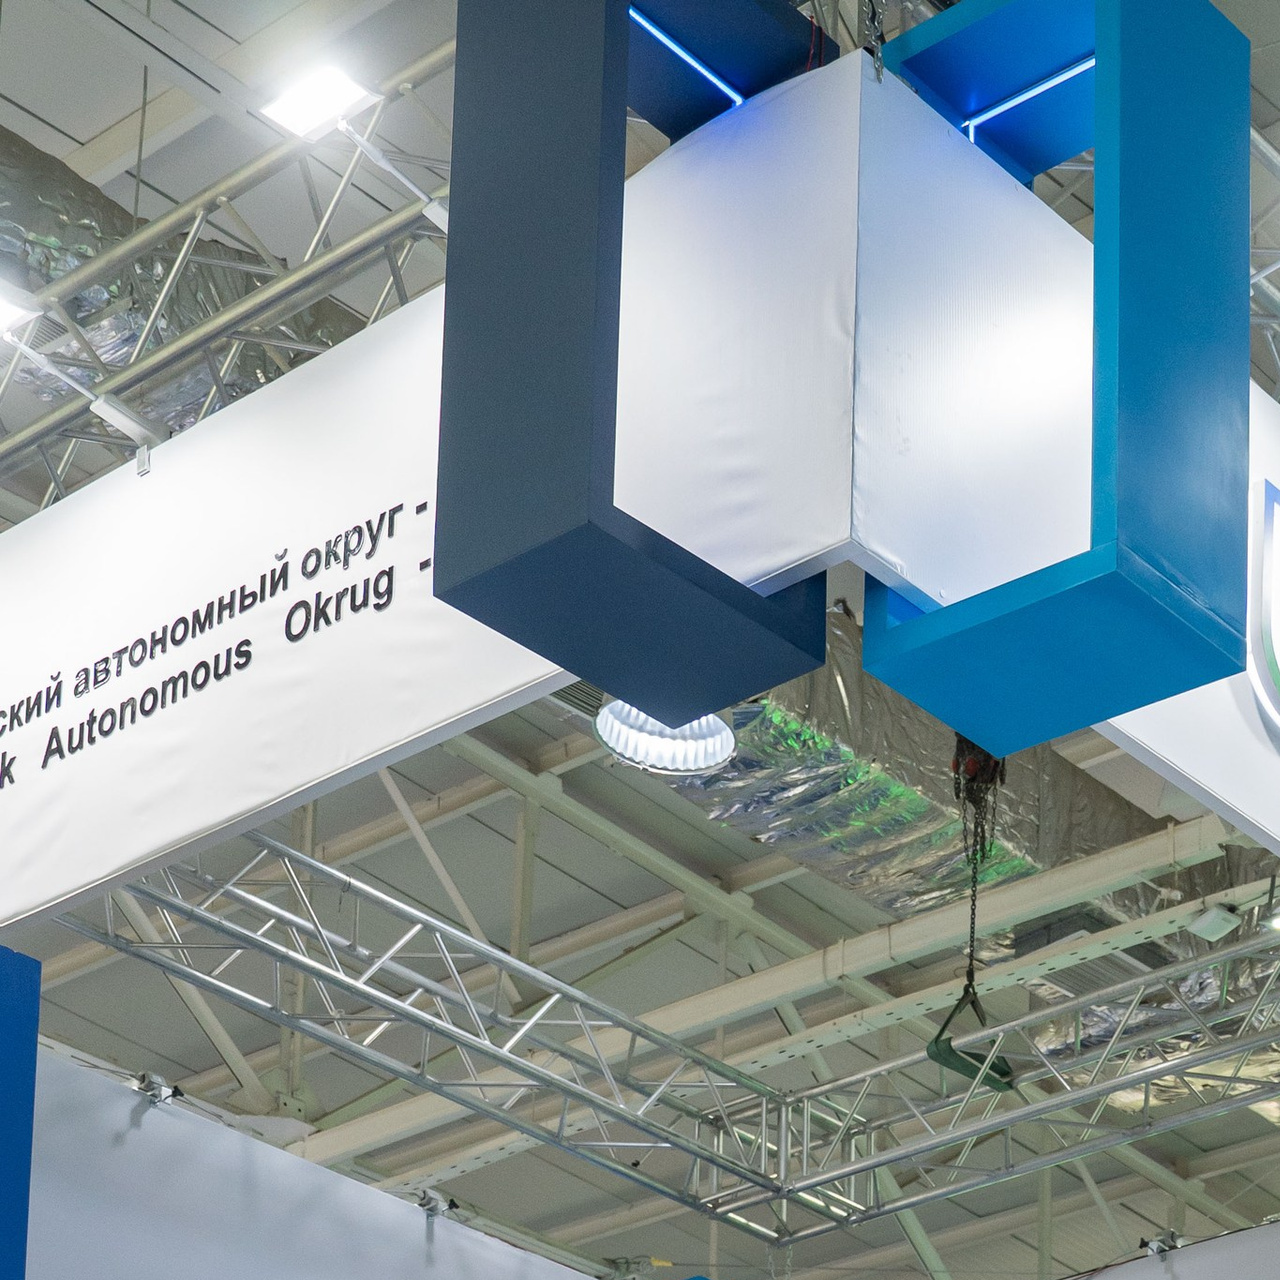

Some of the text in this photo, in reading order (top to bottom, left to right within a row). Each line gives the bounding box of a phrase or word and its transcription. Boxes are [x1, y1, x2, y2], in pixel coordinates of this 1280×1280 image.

[0, 671, 63, 738] ский
[74, 548, 289, 699] автономный
[301, 503, 404, 581] округ
[41, 637, 253, 769] Autonomous
[284, 565, 395, 643] Okrug
